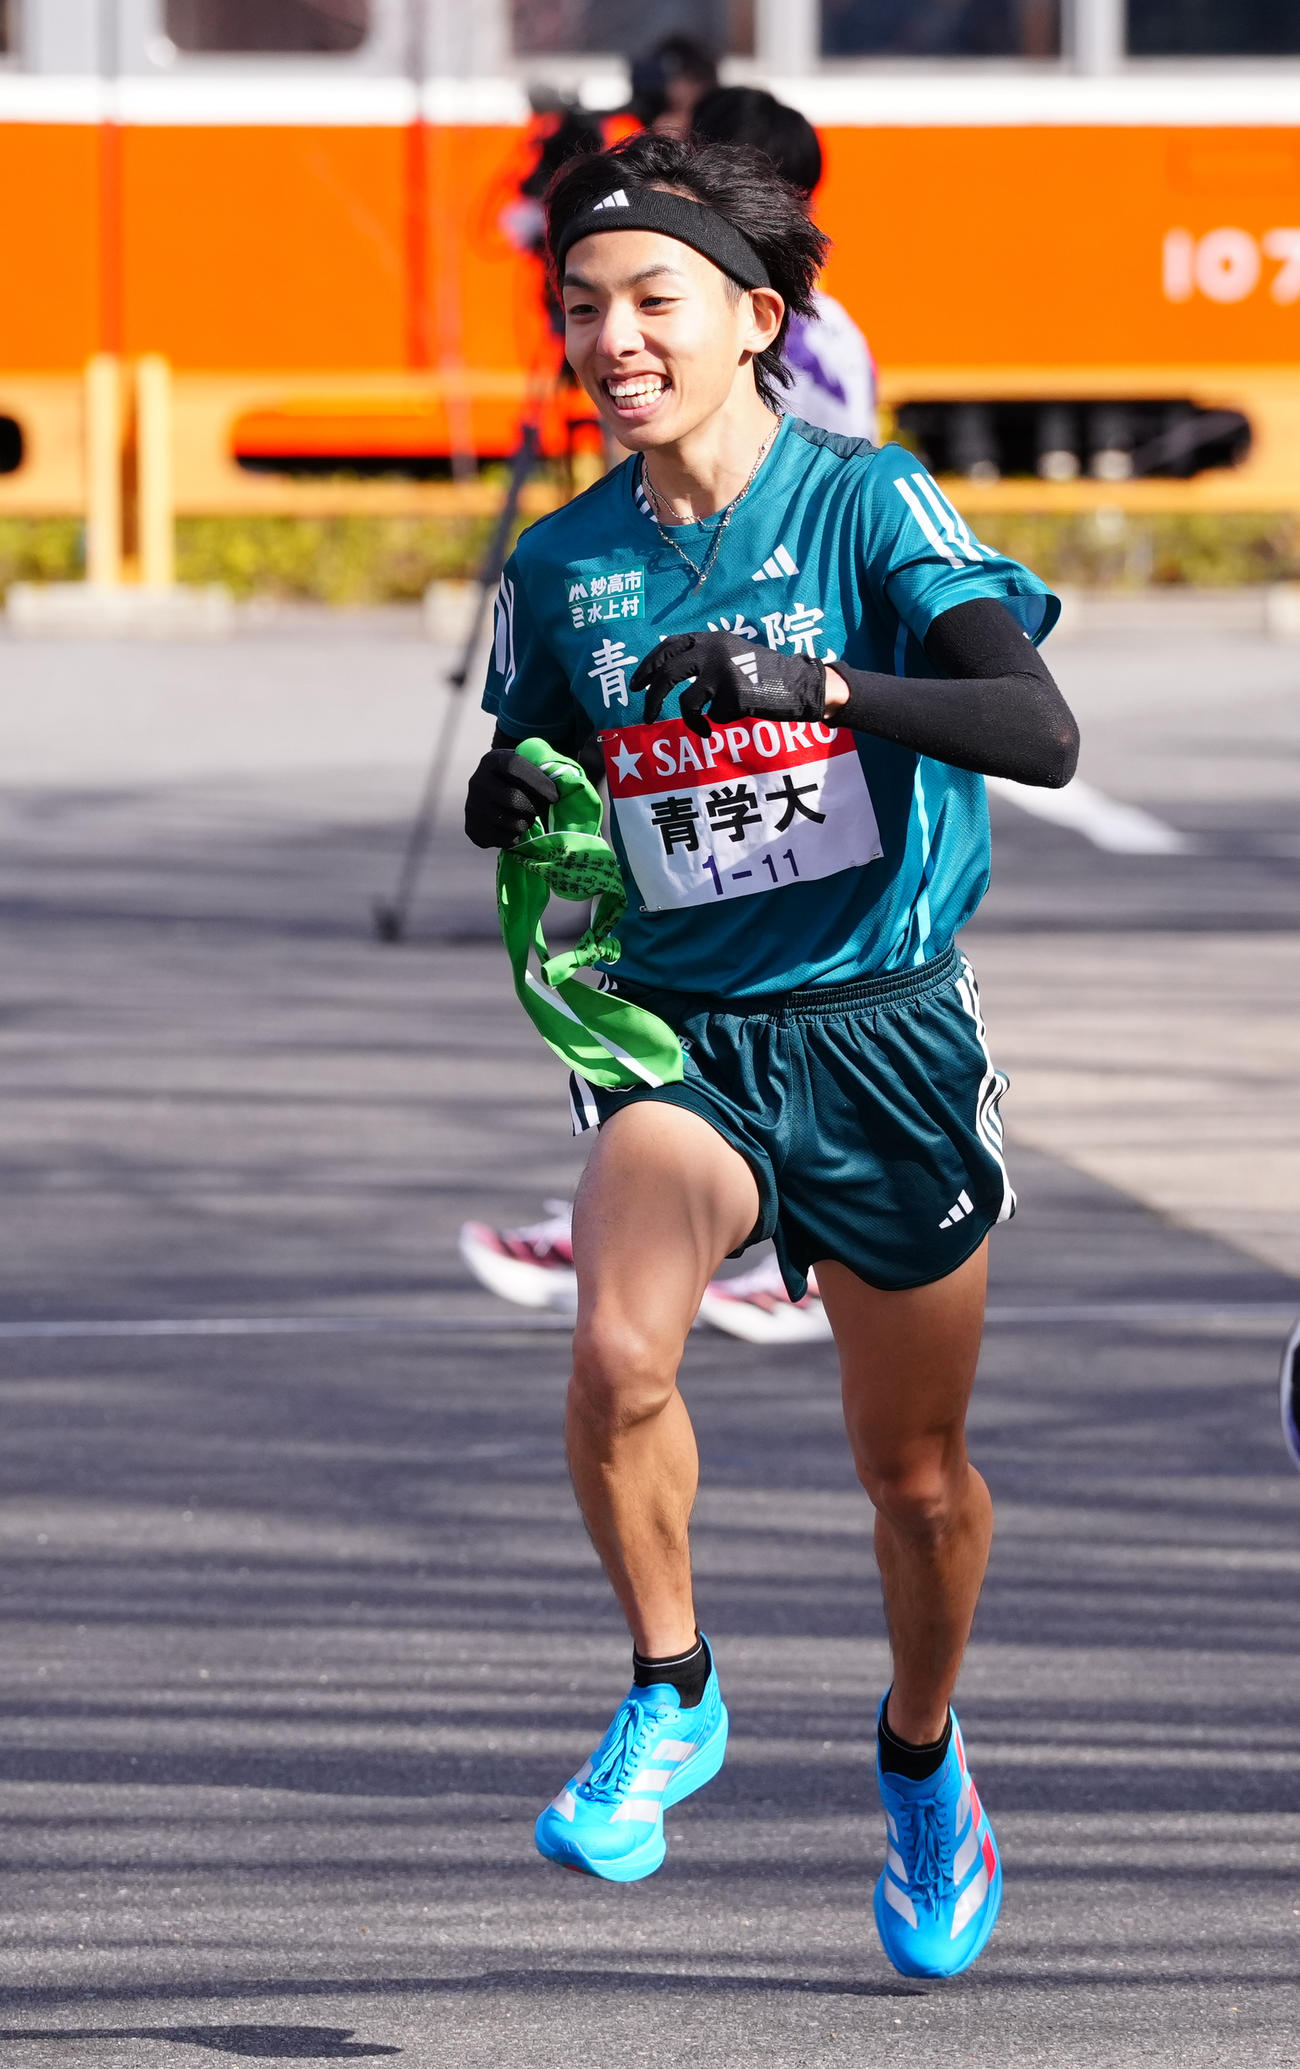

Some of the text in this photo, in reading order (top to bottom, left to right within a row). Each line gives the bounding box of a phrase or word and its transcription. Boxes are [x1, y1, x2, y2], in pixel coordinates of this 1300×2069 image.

[590, 570, 642, 597] 妙高市
[587, 595, 640, 623] 水上村
[587, 602, 838, 709] 青院
[650, 774, 827, 856] 青学大
[701, 848, 801, 896] 1-11
